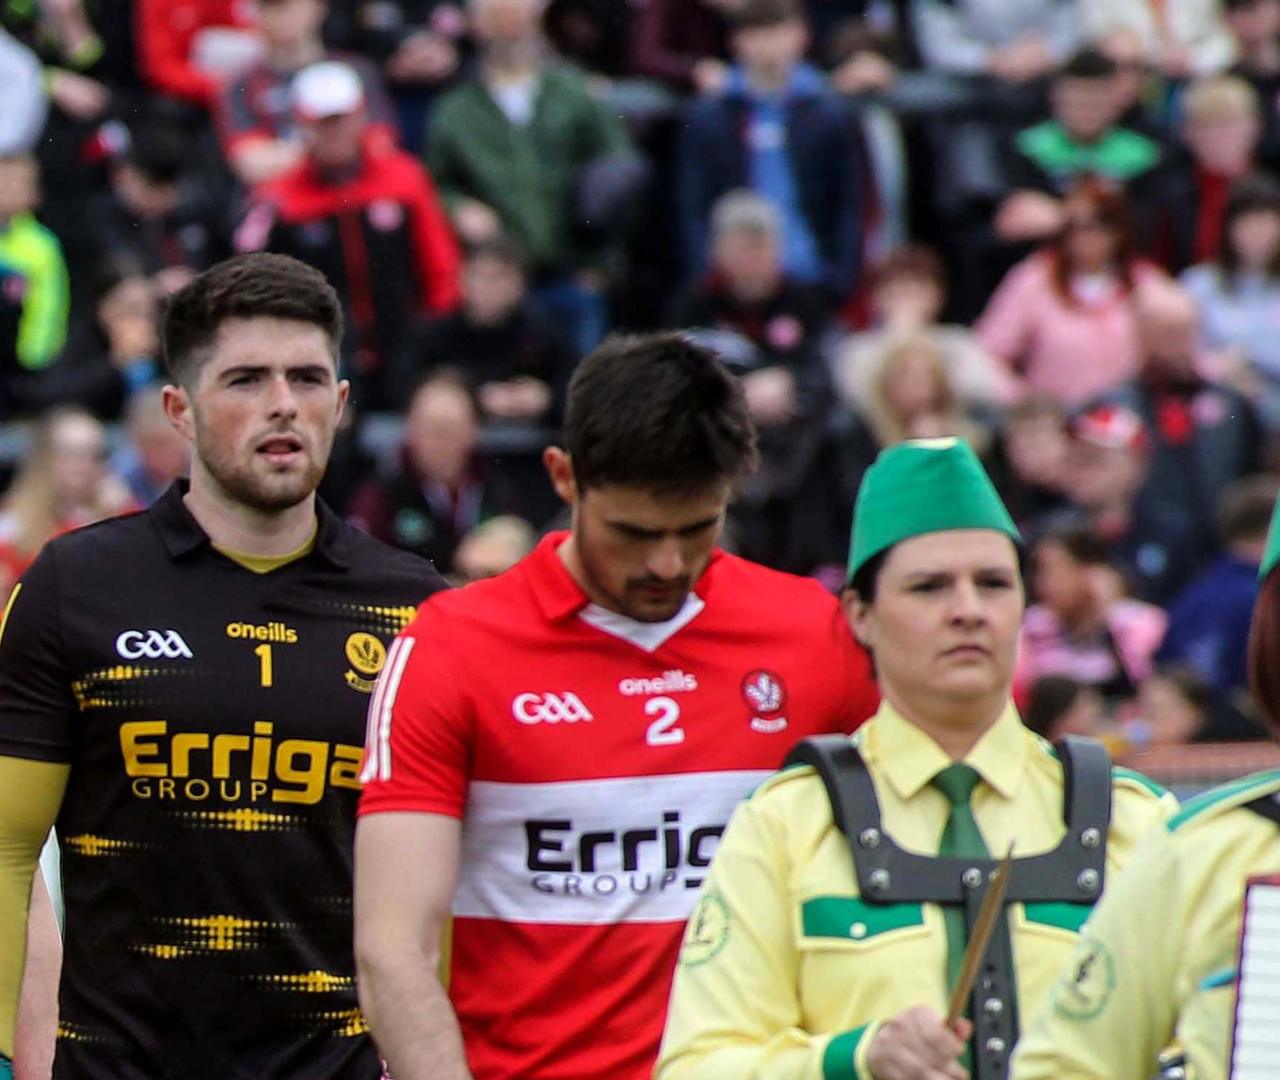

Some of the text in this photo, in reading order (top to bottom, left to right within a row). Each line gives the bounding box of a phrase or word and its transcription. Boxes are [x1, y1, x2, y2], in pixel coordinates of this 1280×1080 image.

[254, 643, 274, 687] 1
[644, 697, 686, 745] 2
[132, 777, 268, 802] GROUP
[532, 872, 677, 896] GROUP
